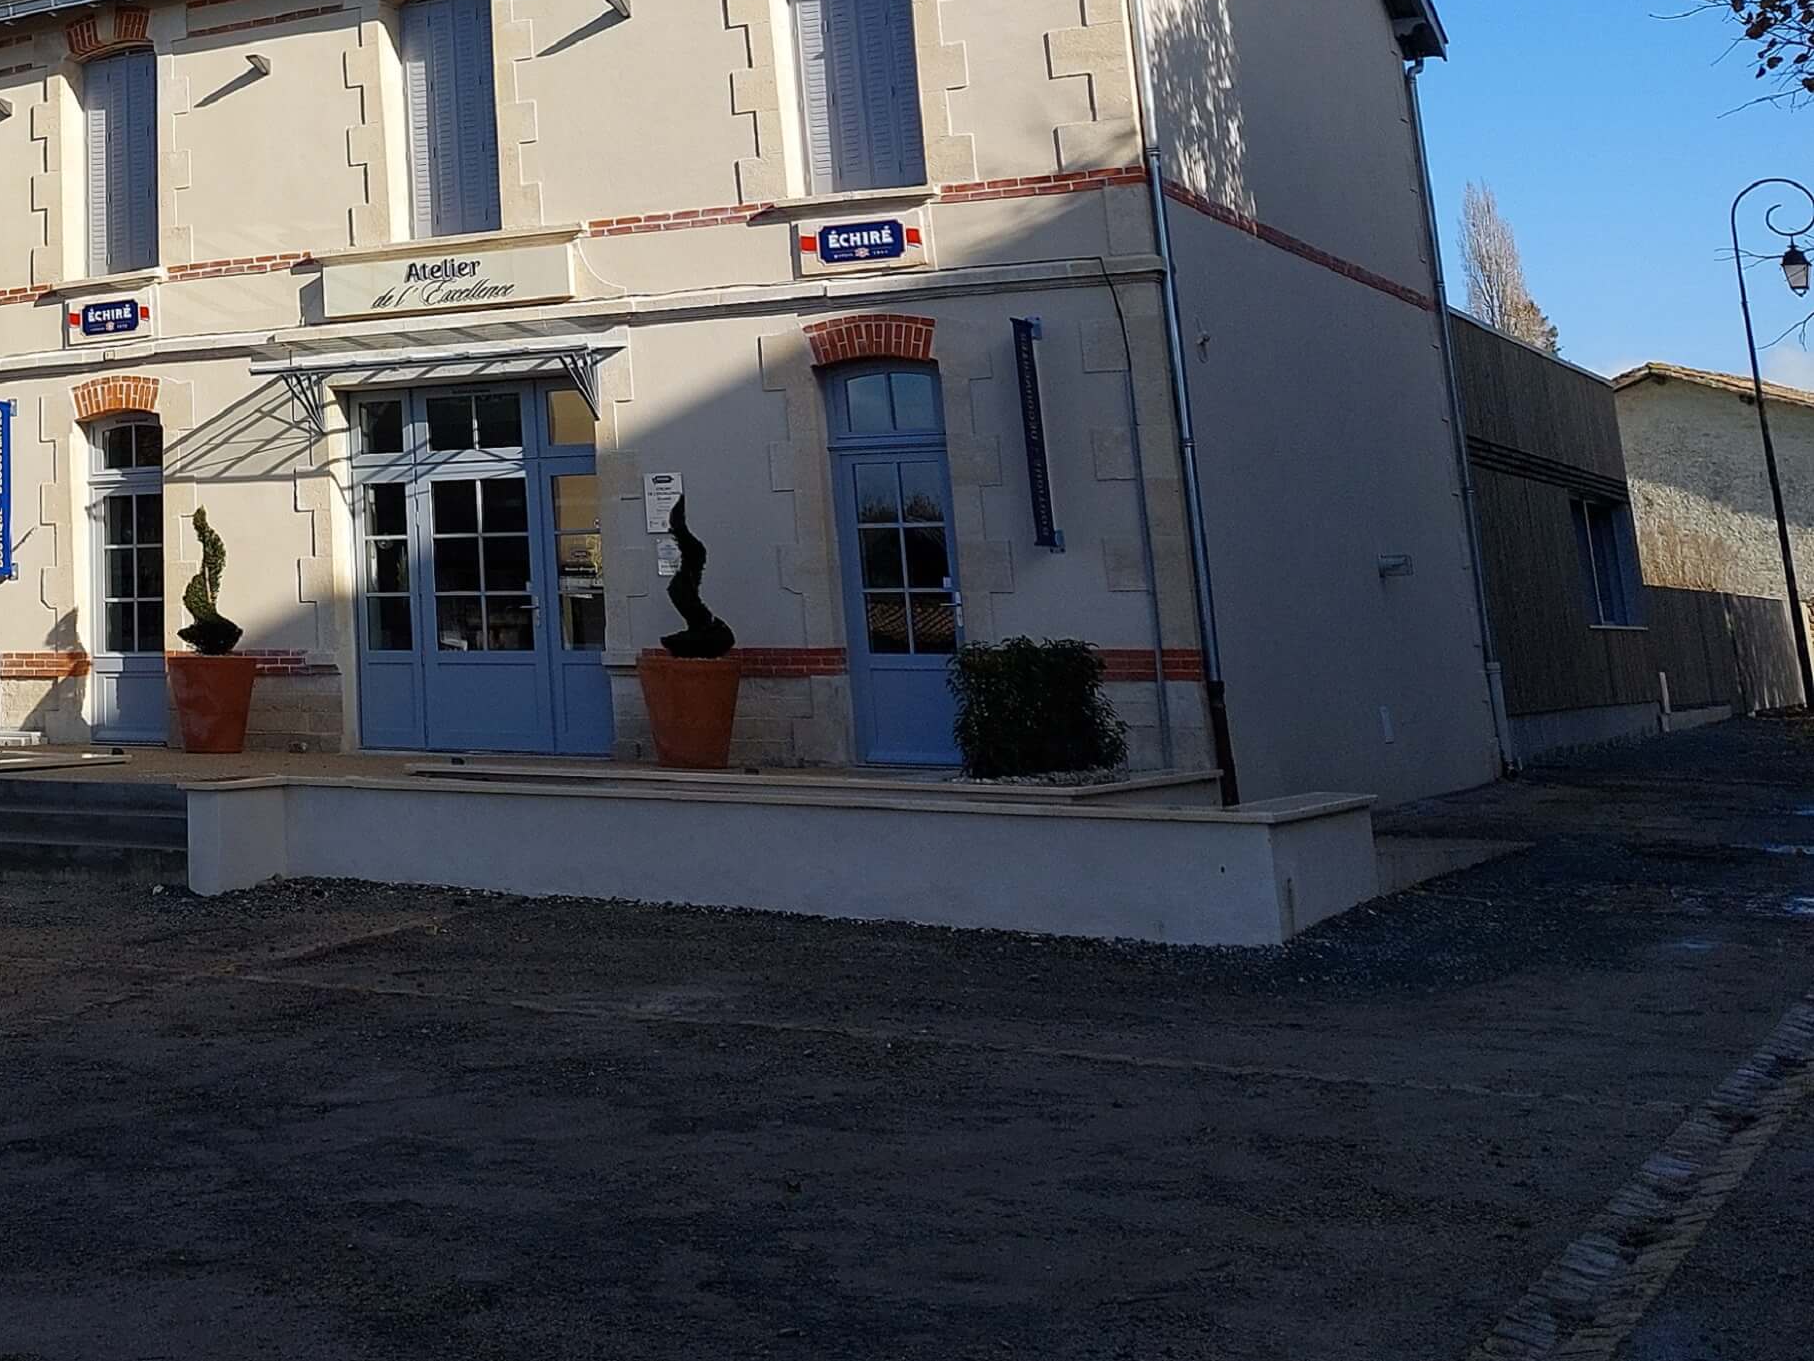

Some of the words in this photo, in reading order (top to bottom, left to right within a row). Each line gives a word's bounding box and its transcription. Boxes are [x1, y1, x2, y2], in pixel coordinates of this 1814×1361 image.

[828, 225, 894, 249] ÉCHIRÉ
[404, 258, 481, 282] Atelier
[370, 287, 396, 309] de
[87, 304, 132, 322] ÉCHIRÉ
